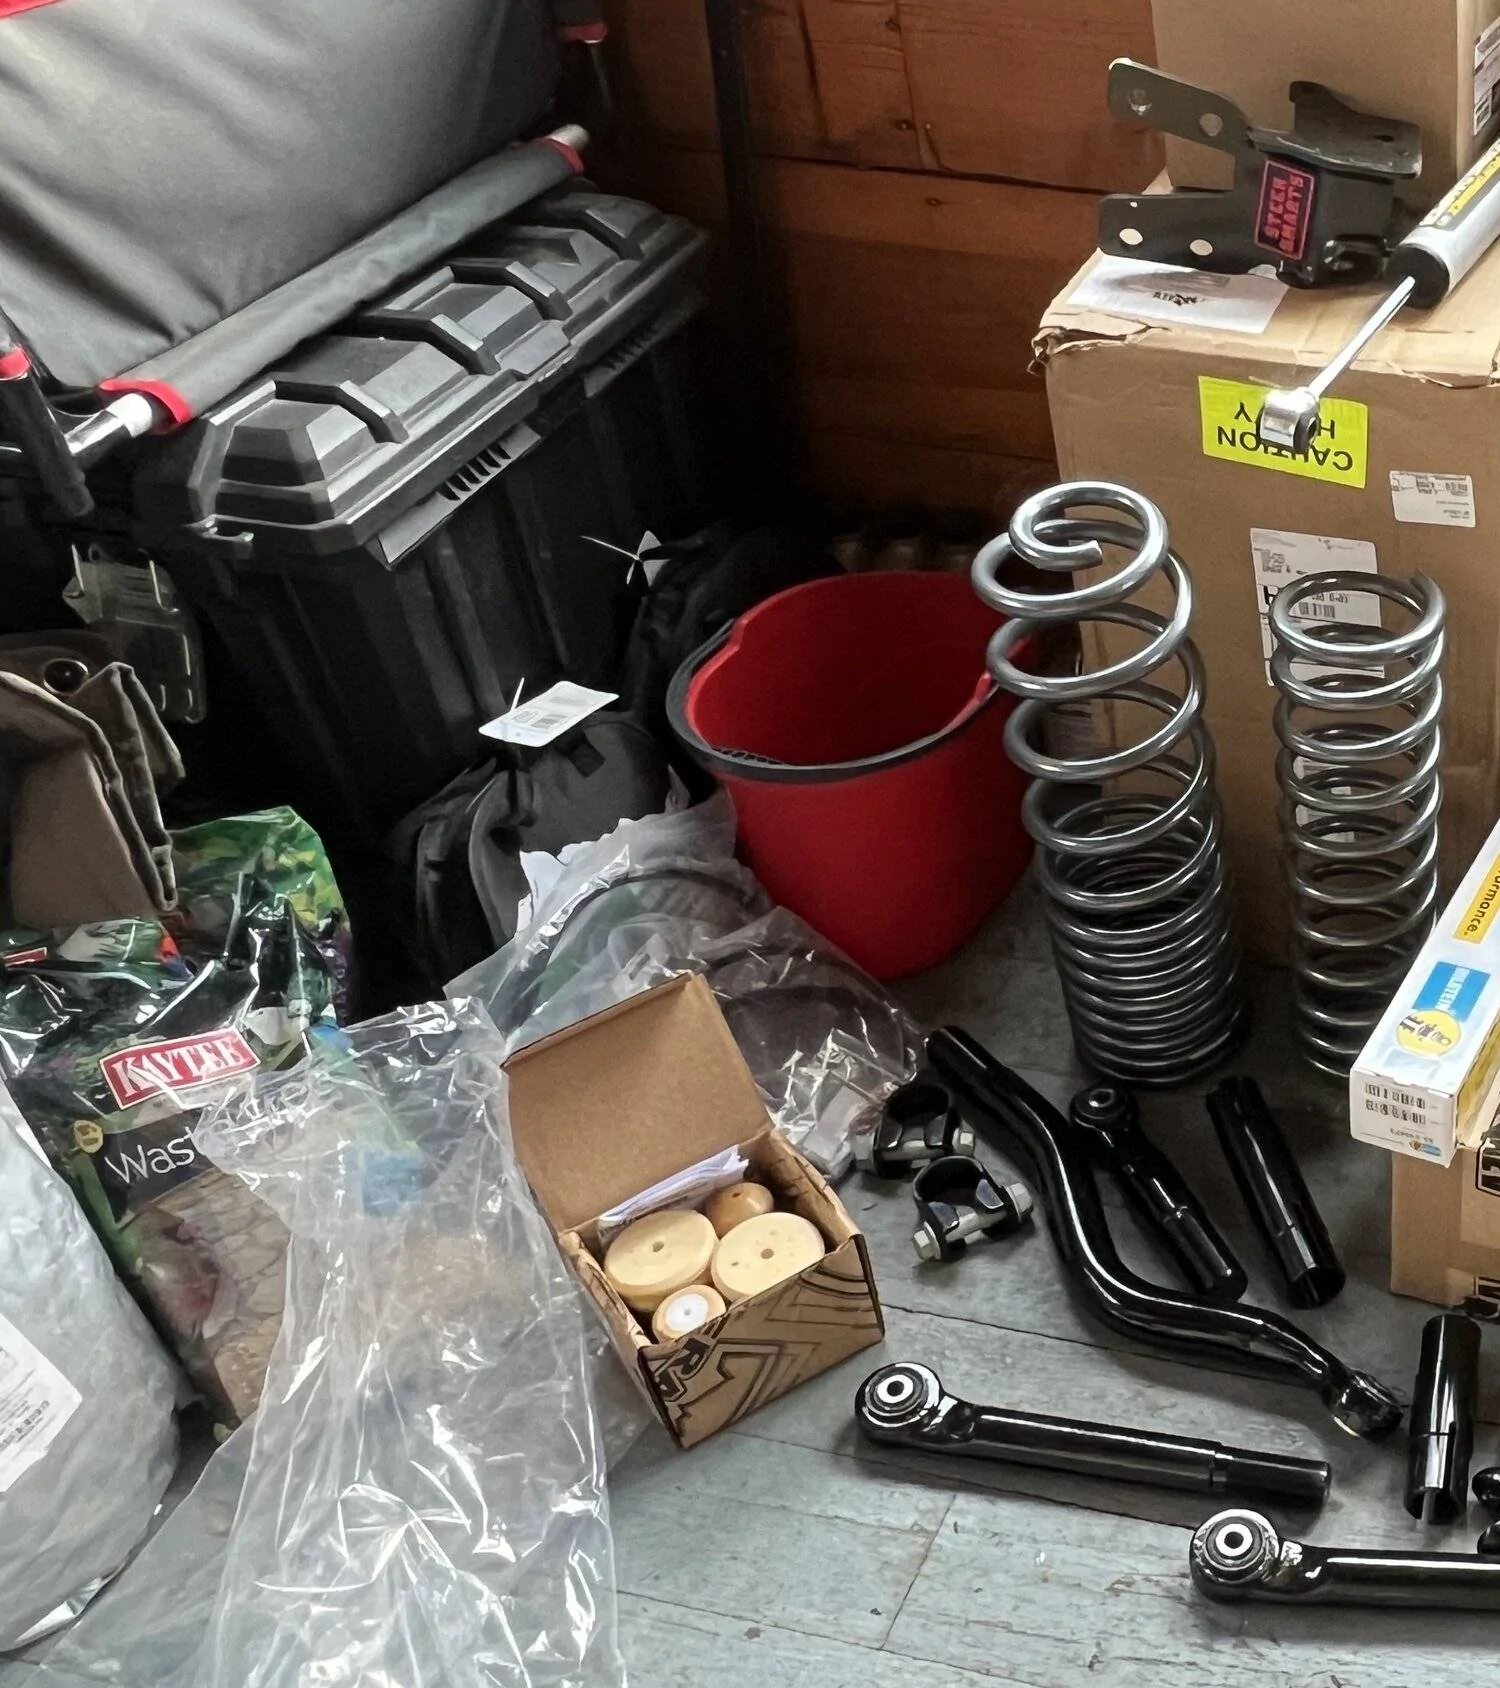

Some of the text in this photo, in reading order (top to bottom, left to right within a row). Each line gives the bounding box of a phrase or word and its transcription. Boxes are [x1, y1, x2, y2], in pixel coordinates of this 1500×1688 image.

[1264, 177, 1288, 239] STEER
[1279, 174, 1304, 252] SMARTS
[111, 1036, 247, 1098] KAYTEE
